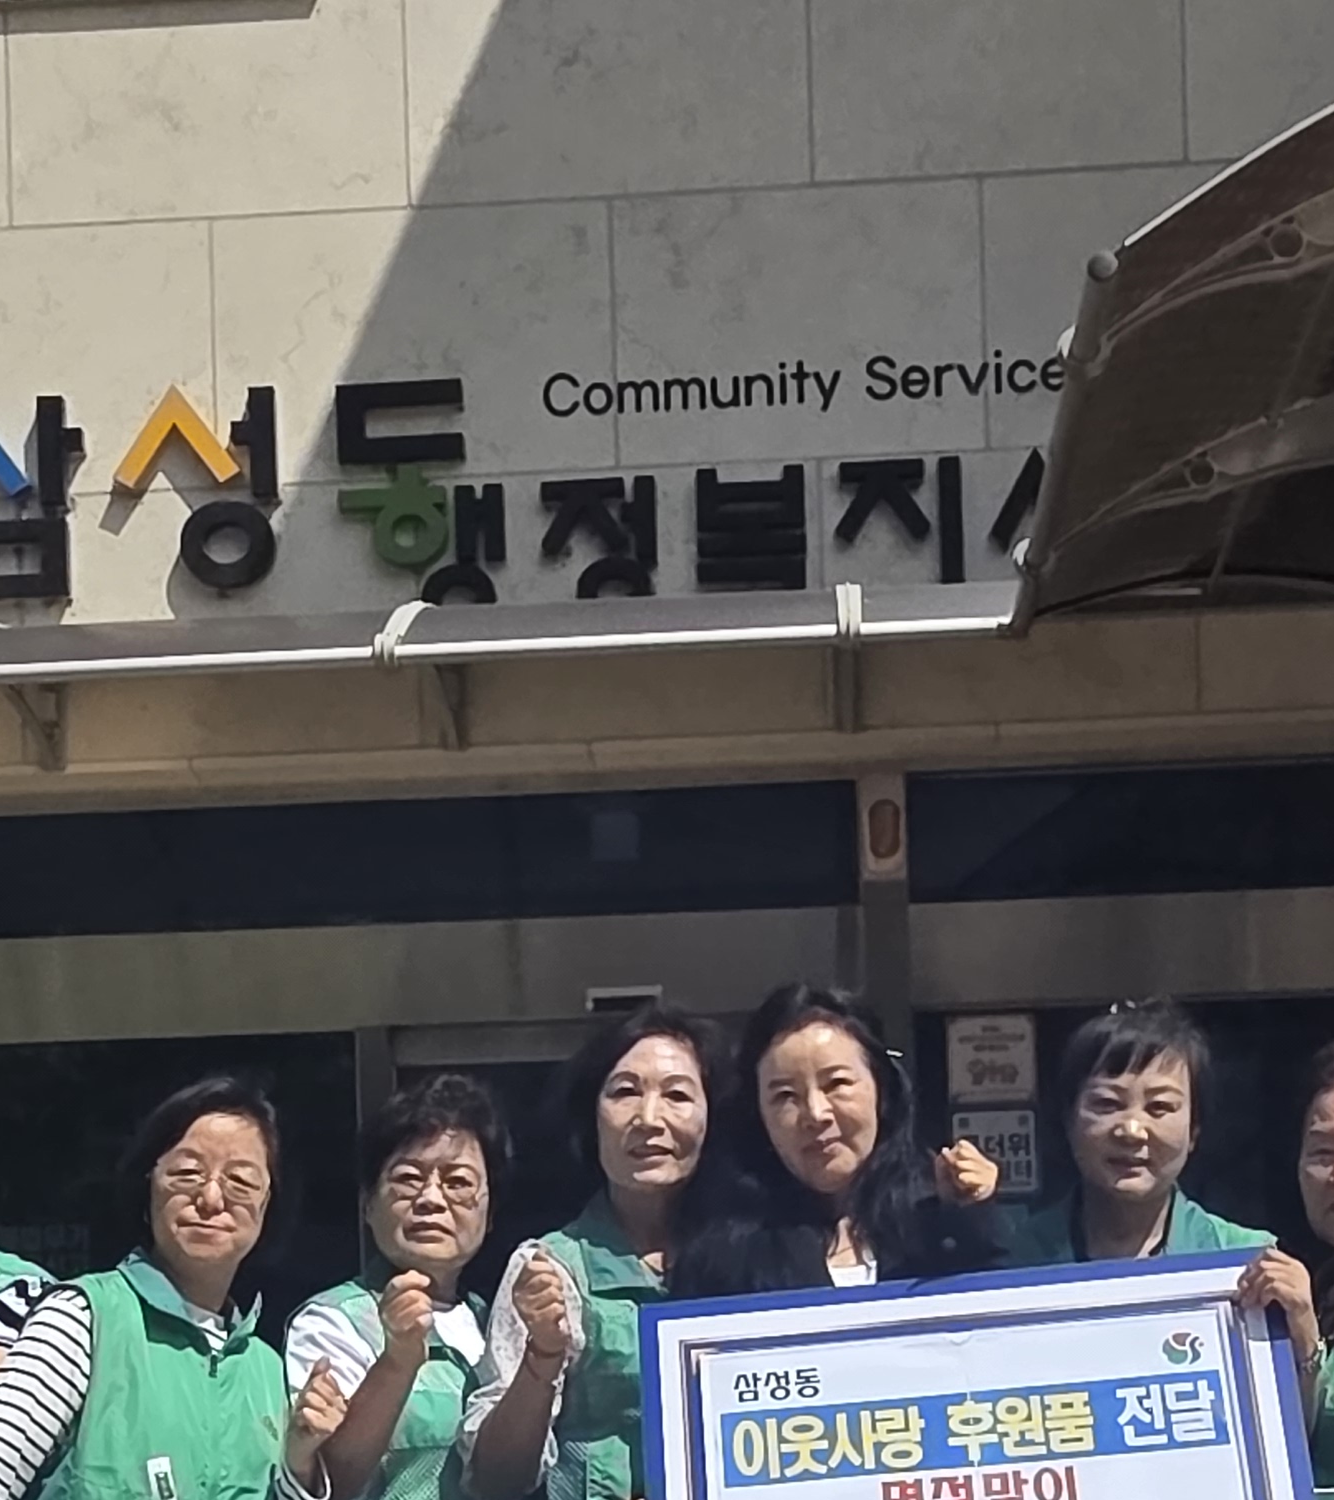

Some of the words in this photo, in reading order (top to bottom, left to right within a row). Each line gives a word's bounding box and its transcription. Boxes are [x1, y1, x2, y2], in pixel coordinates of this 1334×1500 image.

[543, 360, 841, 418] Community
[865, 349, 1065, 400] Service
[337, 446, 1044, 603] 행정복지
[733, 1366, 822, 1403] 삼성동
[731, 1404, 926, 1480] 이웃사랑
[946, 1390, 1096, 1462] 후원품
[1115, 1377, 1218, 1446] 전달
